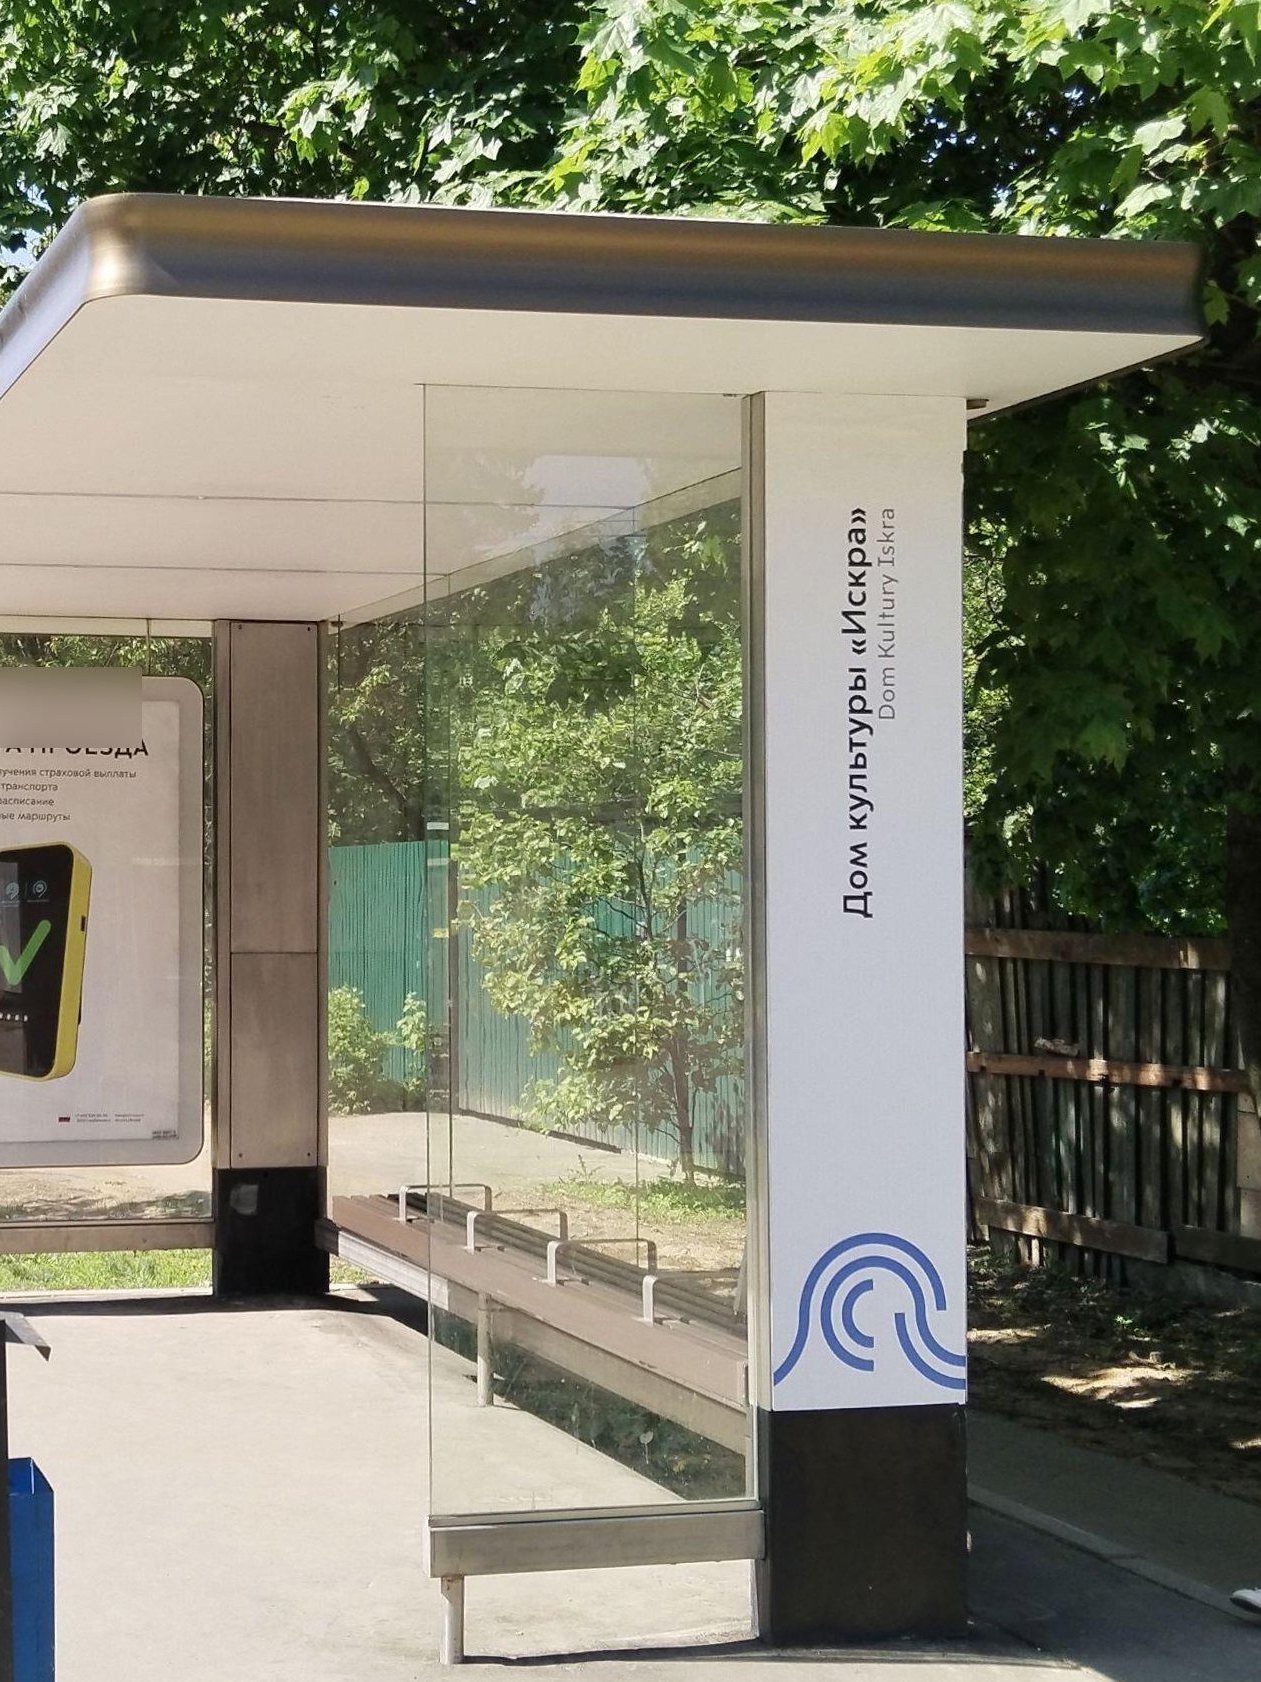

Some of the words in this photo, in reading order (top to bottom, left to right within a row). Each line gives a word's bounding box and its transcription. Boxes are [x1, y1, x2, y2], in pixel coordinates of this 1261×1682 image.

[877, 508, 896, 567] Iskra
[841, 507, 872, 655] «Искра»
[877, 573, 899, 659] Kultury
[878, 667, 895, 720] Dom
[39, 768, 91, 778] страховой
[93, 770, 137, 778] выплаты
[848, 667, 875, 830] культуры
[1, 782, 59, 792] транспорта
[17, 813, 71, 822] маршруты
[842, 841, 874, 919] Дом
